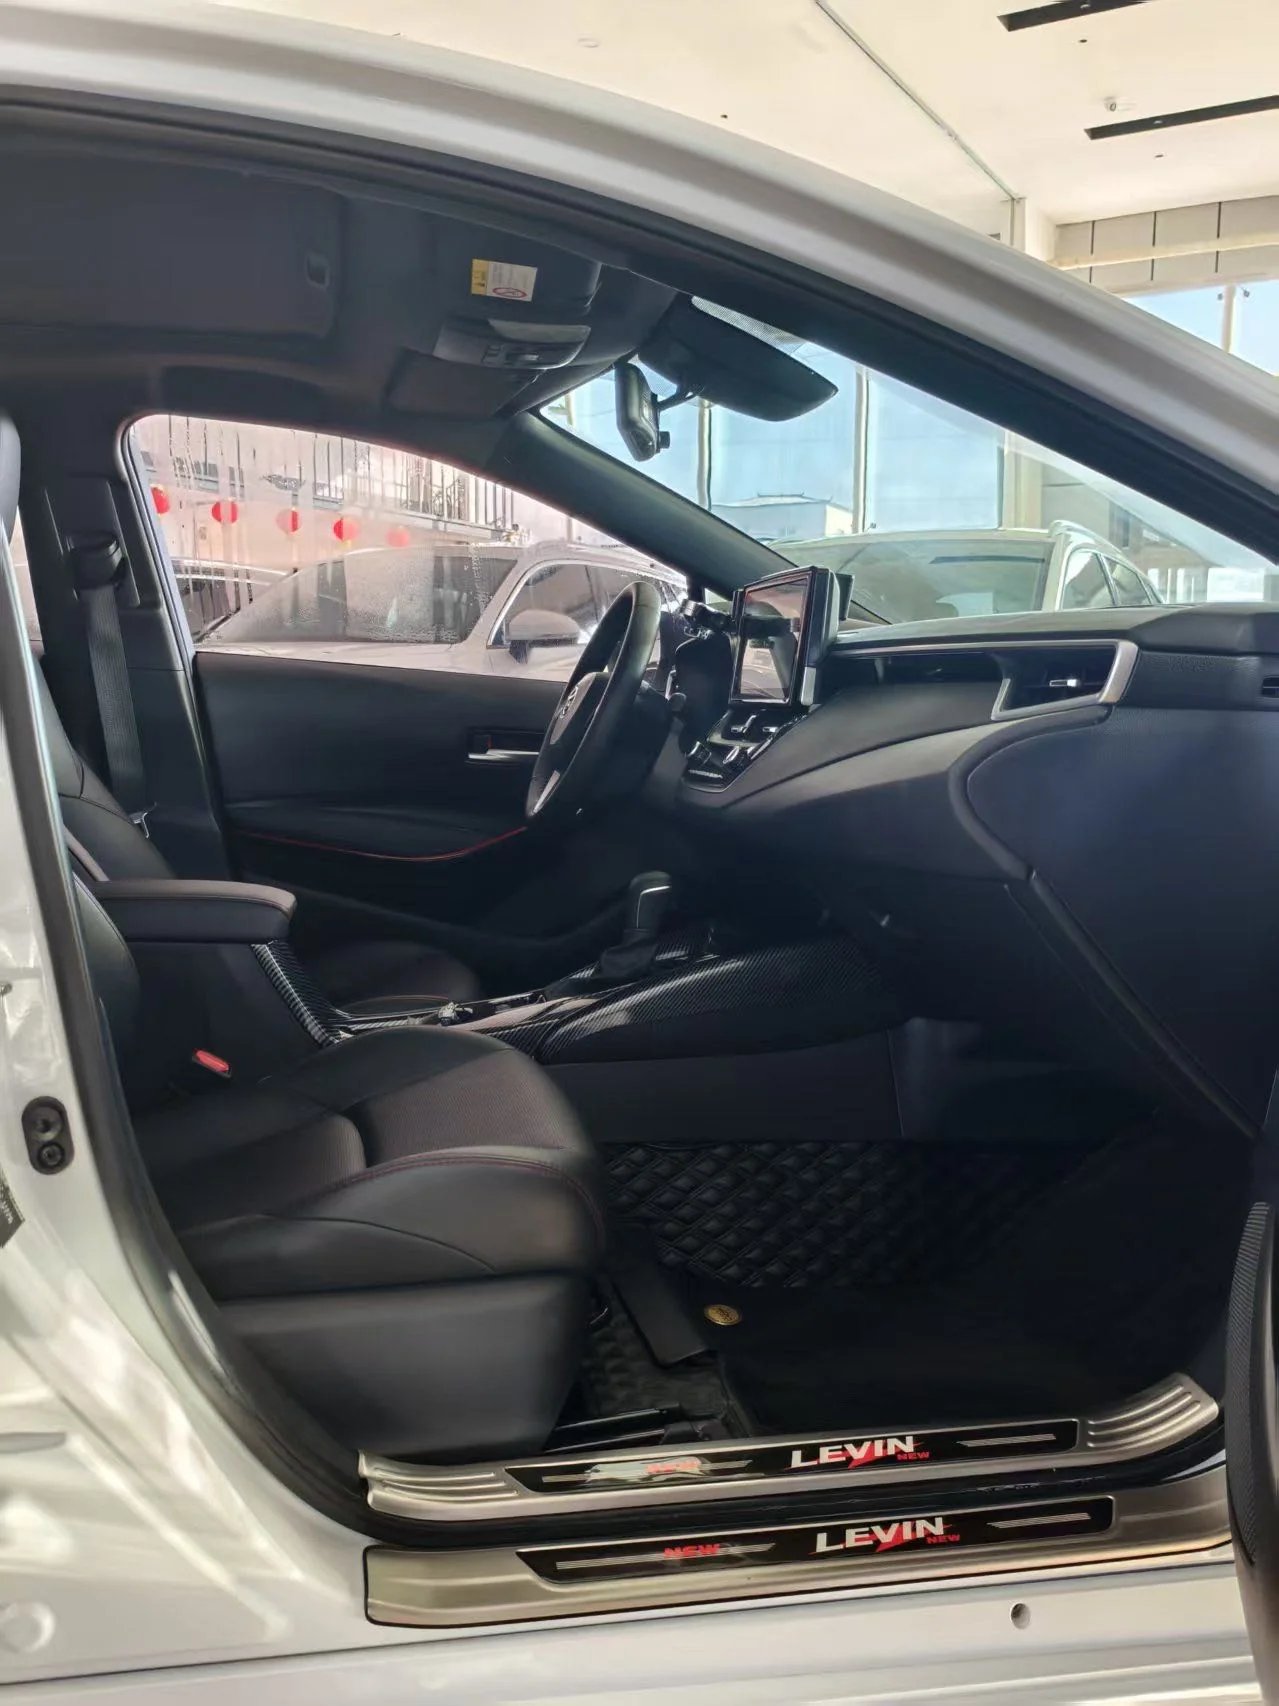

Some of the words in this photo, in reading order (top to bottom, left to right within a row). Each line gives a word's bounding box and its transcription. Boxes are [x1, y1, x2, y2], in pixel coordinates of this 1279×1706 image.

[791, 1436, 914, 1468] LEVIN
[897, 1451, 930, 1461] NEW
[816, 1517, 944, 1553] LEVIN
[927, 1534, 961, 1544] NEW
